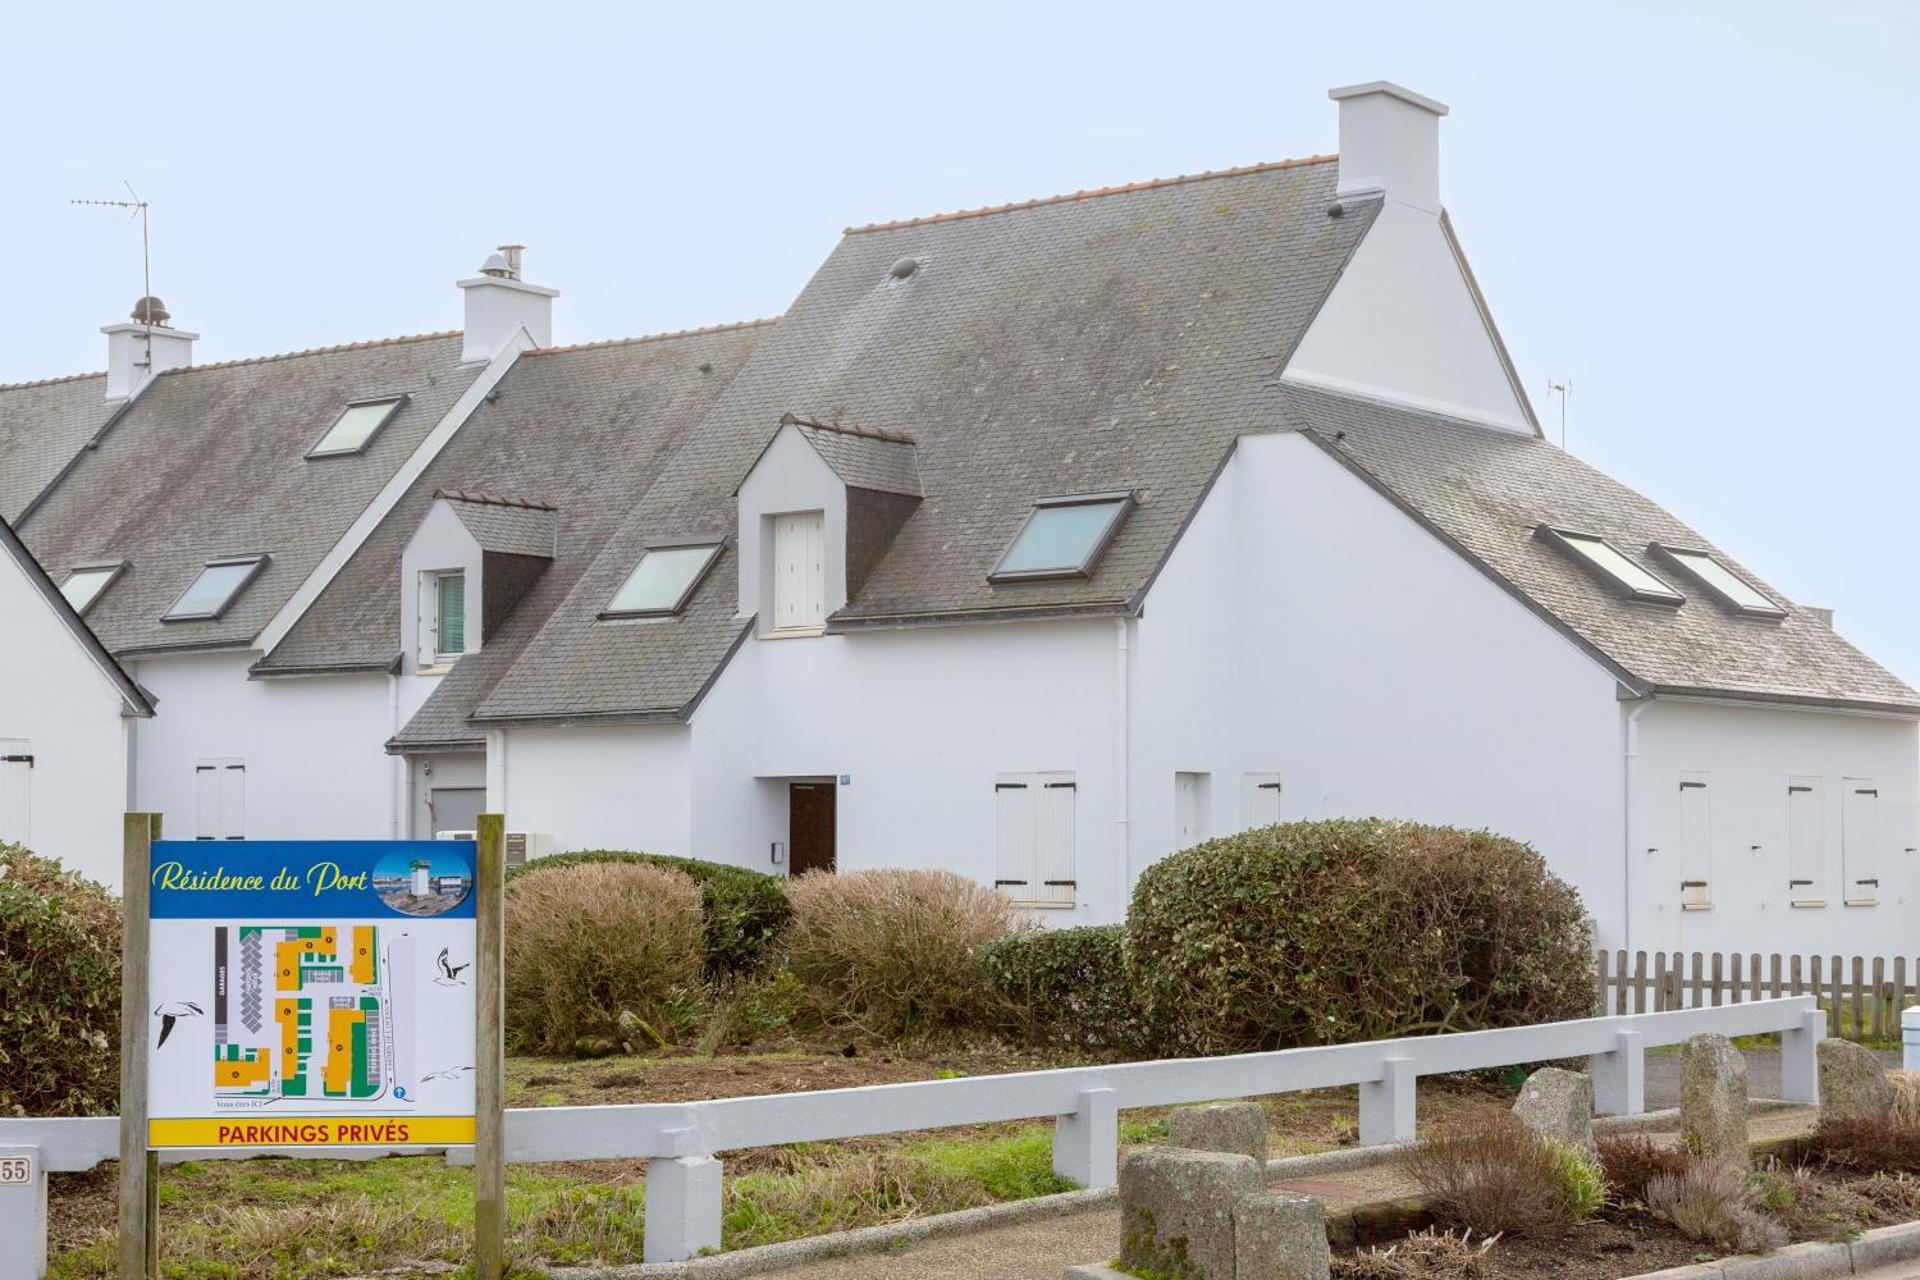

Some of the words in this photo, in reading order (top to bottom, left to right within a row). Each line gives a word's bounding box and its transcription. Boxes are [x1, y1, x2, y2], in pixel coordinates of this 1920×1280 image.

[152, 861, 265, 891] Résidence
[270, 866, 301, 891] du
[306, 862, 368, 897] Port
[218, 1125, 329, 1143] PARKINGS
[337, 1120, 409, 1142] PRIVÉS
